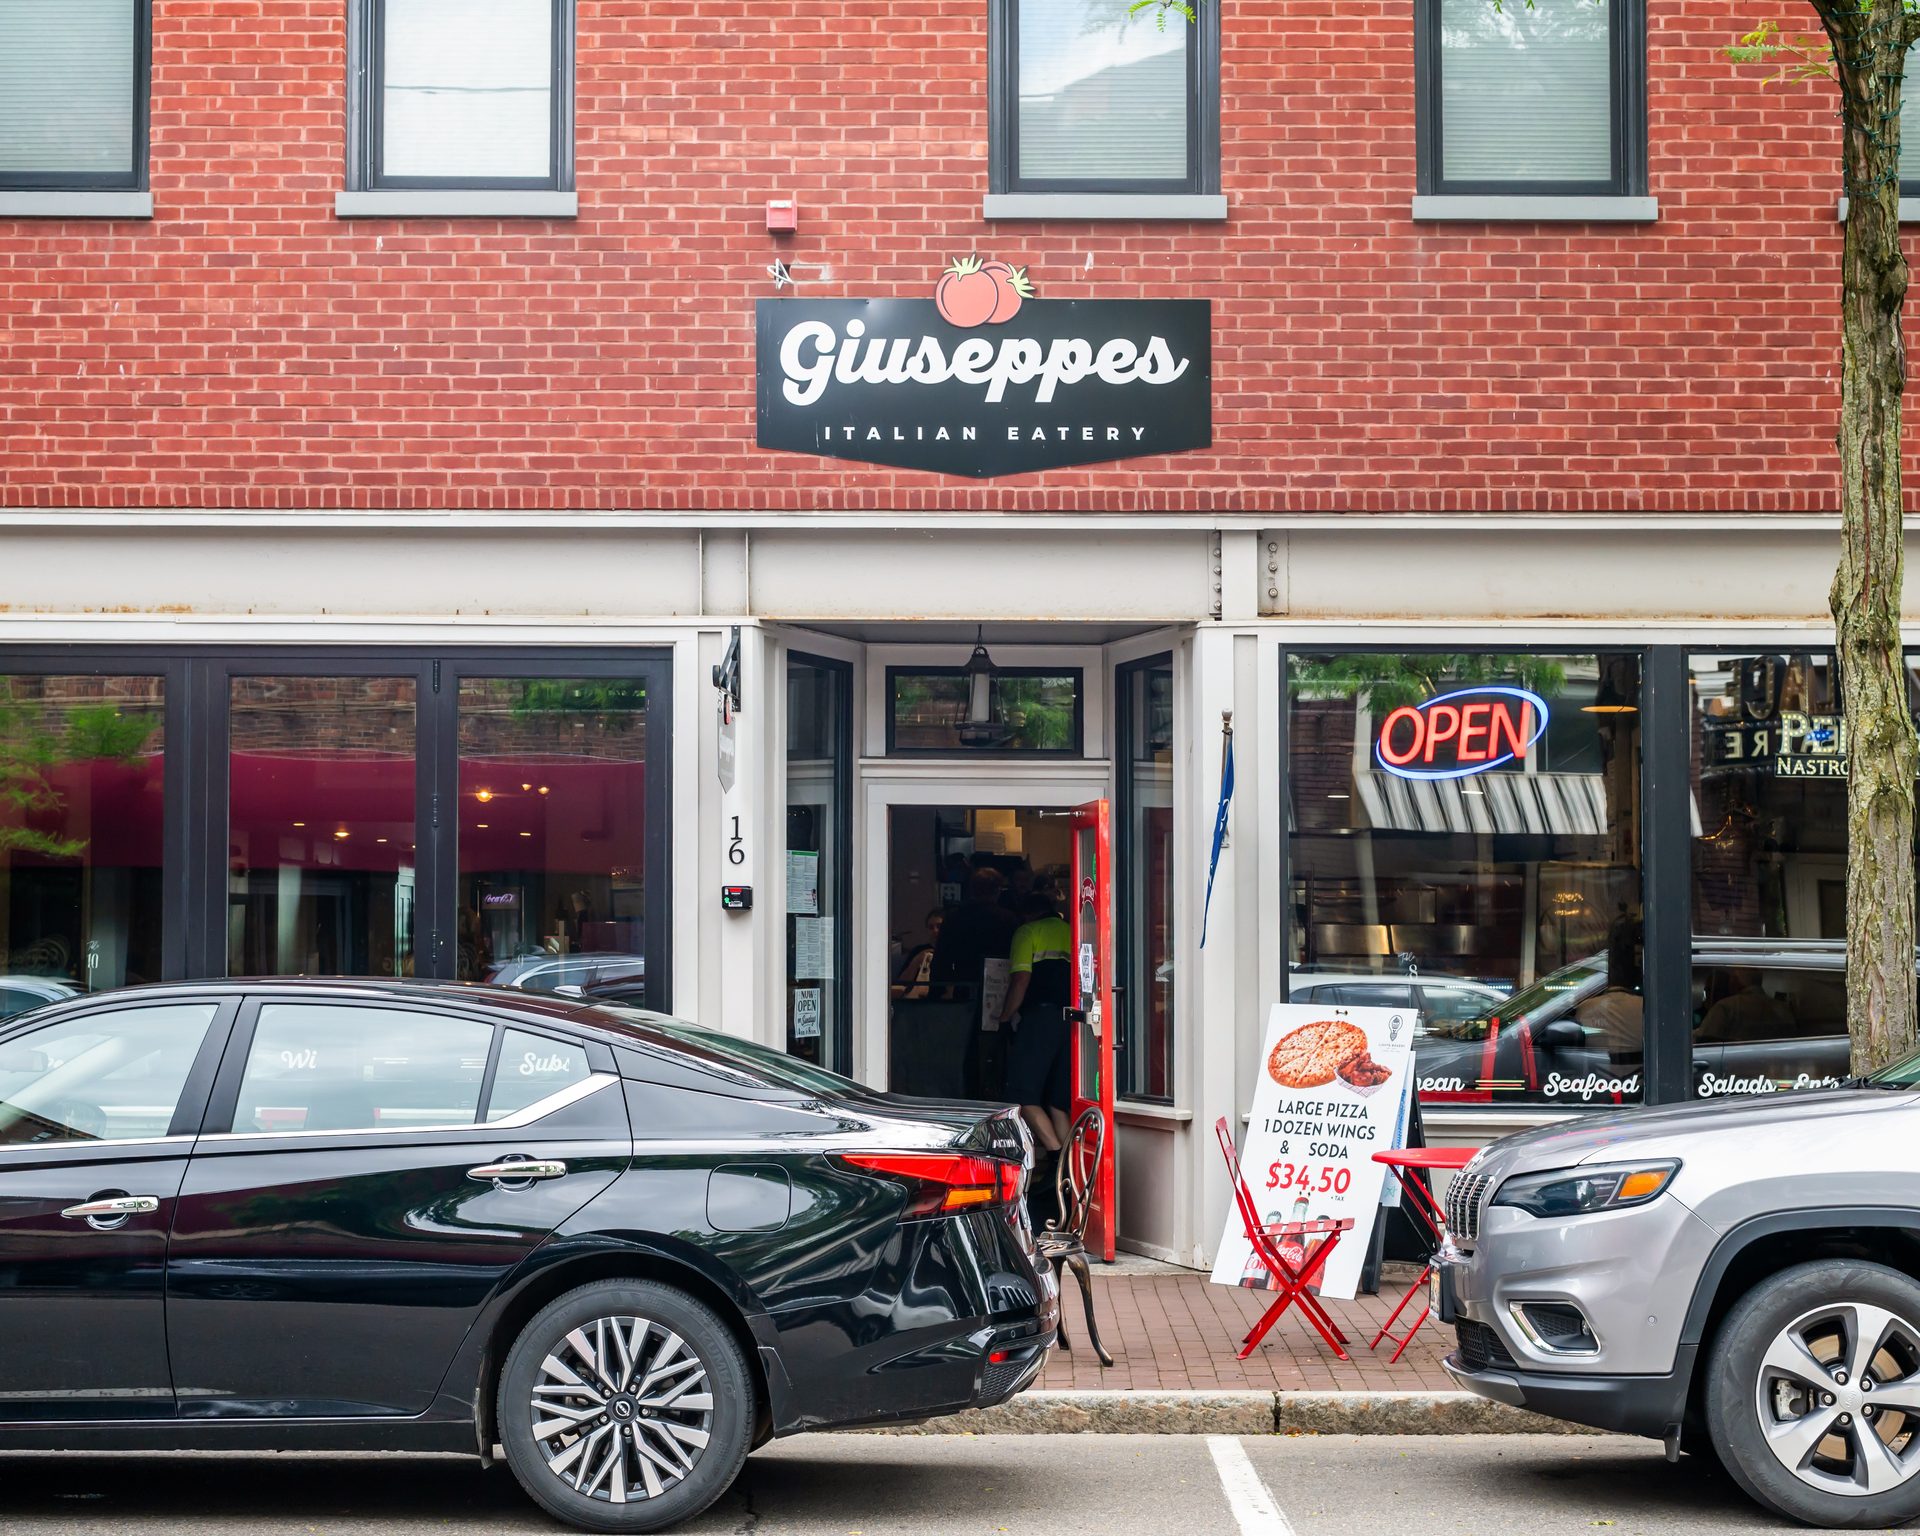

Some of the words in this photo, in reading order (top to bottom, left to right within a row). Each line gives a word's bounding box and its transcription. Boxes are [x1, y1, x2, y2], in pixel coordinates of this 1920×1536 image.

[779, 318, 1190, 406] Giuseppes
[825, 426, 977, 441] ITALIAN
[1007, 426, 1146, 441] EATERY
[1380, 700, 1532, 765] OPEN
[797, 1000, 817, 1012] OPEN
[1543, 1072, 1640, 1100] Seafood
[1698, 1072, 1777, 1097] Salads
[1277, 1099, 1324, 1116] LARGE
[1326, 1103, 1369, 1119] PIZZA
[1264, 1119, 1270, 1133] 1
[1272, 1119, 1323, 1136] DOZEN
[1327, 1122, 1376, 1140] WINGS
[1280, 1140, 1289, 1154] &
[1308, 1142, 1348, 1159] SODA
[1265, 1158, 1351, 1194] $34.50
